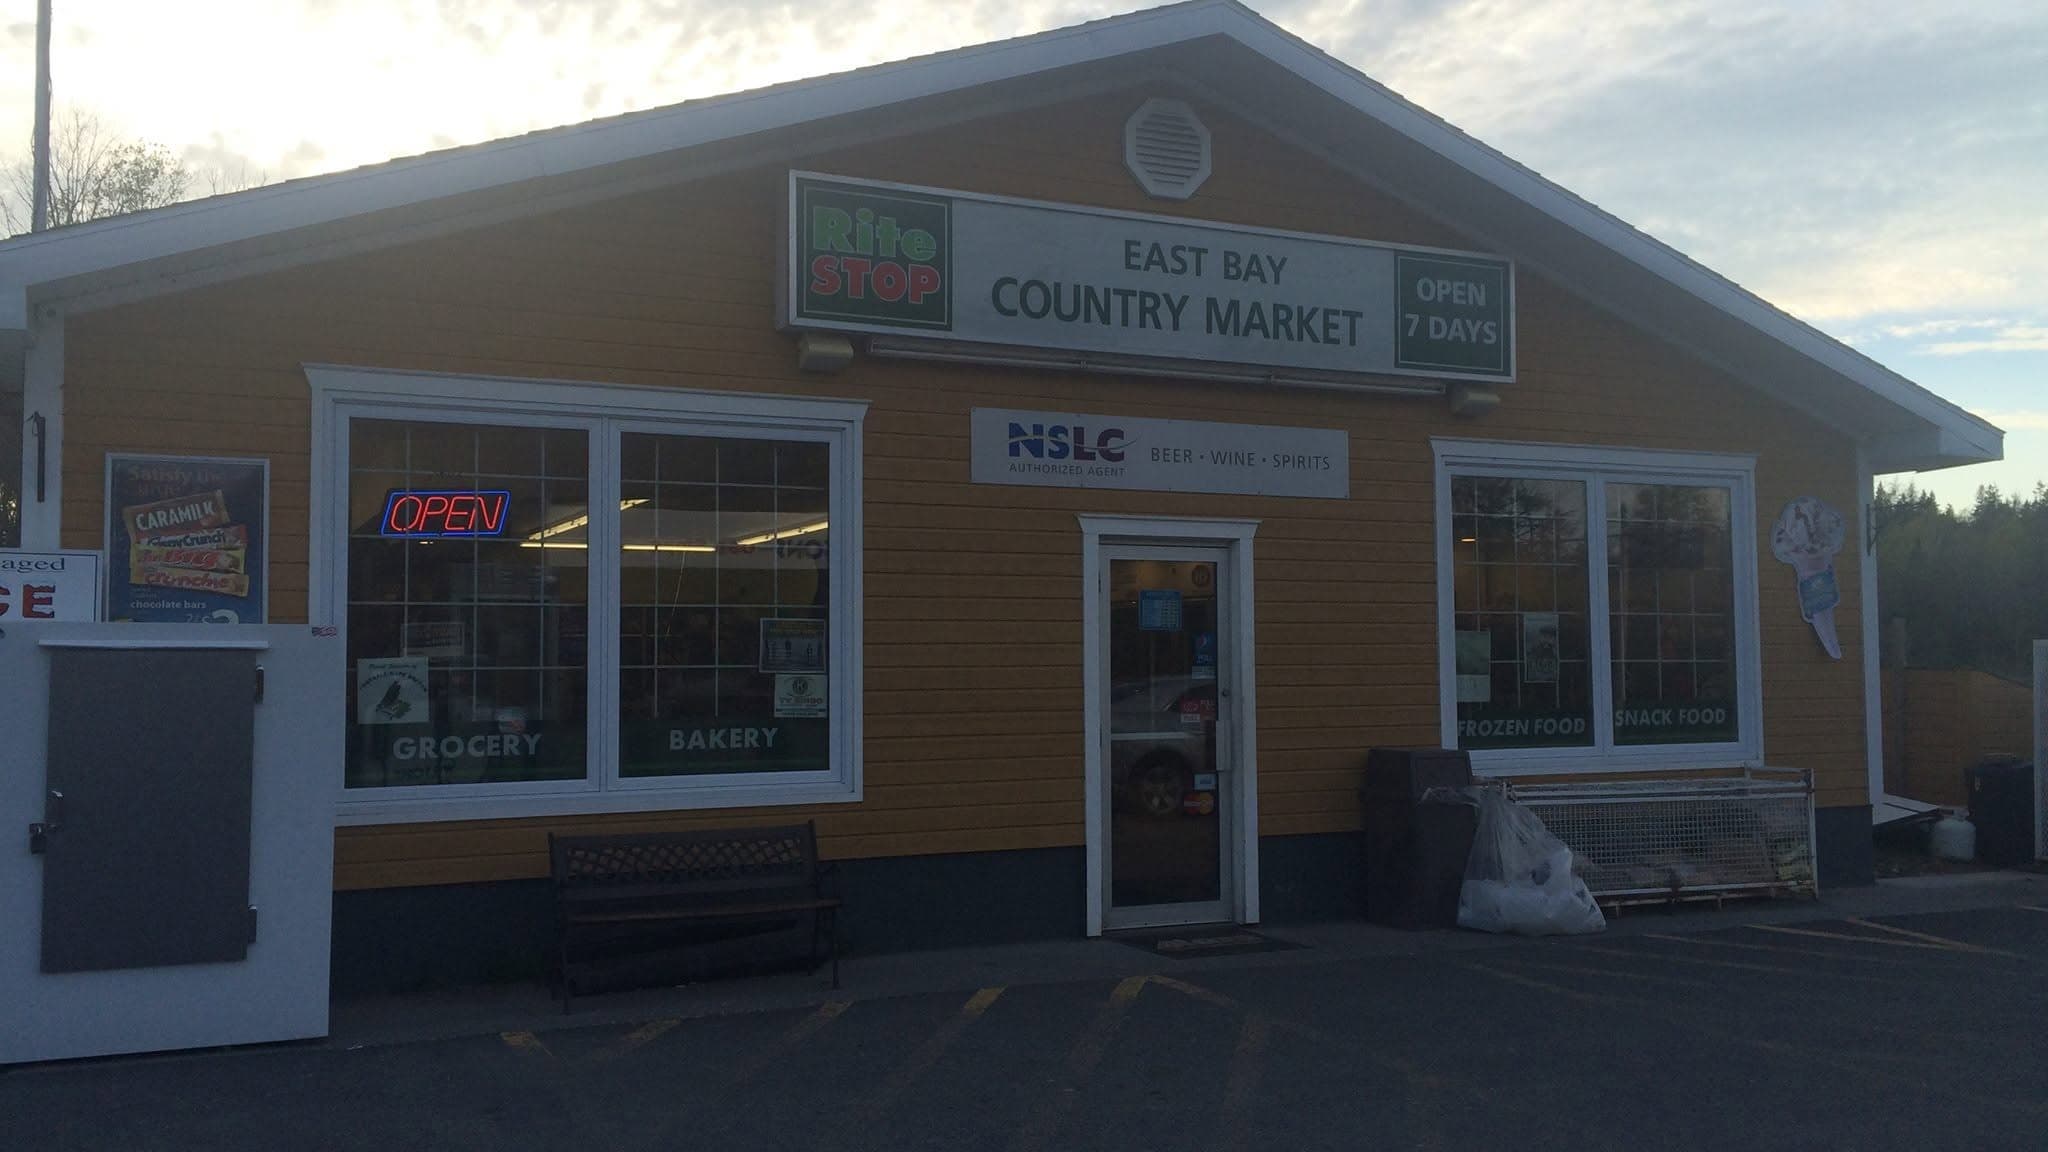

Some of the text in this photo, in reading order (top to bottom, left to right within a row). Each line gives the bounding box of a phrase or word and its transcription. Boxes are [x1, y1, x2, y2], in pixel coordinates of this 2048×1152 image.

[813, 206, 937, 261] Rite
[1124, 239, 1288, 285] EAST BAY
[810, 255, 941, 304] STOP
[1416, 278, 1486, 306] OPEN
[991, 276, 1363, 346] COUNTRY MARKET
[1405, 313, 1496, 344] 7 DAYS
[1008, 422, 1125, 463] NSLC
[1009, 462, 1126, 478] AUTHORIZED AGENT
[1151, 447, 1331, 470] BEER WINE SPIRITS
[136, 501, 216, 531] CARAMILK
[387, 495, 503, 532] OPEN
[2, 557, 65, 573] aged
[130, 599, 206, 609] chocolate bars
[1458, 717, 1586, 737] FROZEN FOOD
[1615, 708, 1726, 727] SNACK FOOD
[392, 733, 542, 760] GROCERY
[669, 727, 778, 751] BAKERY
